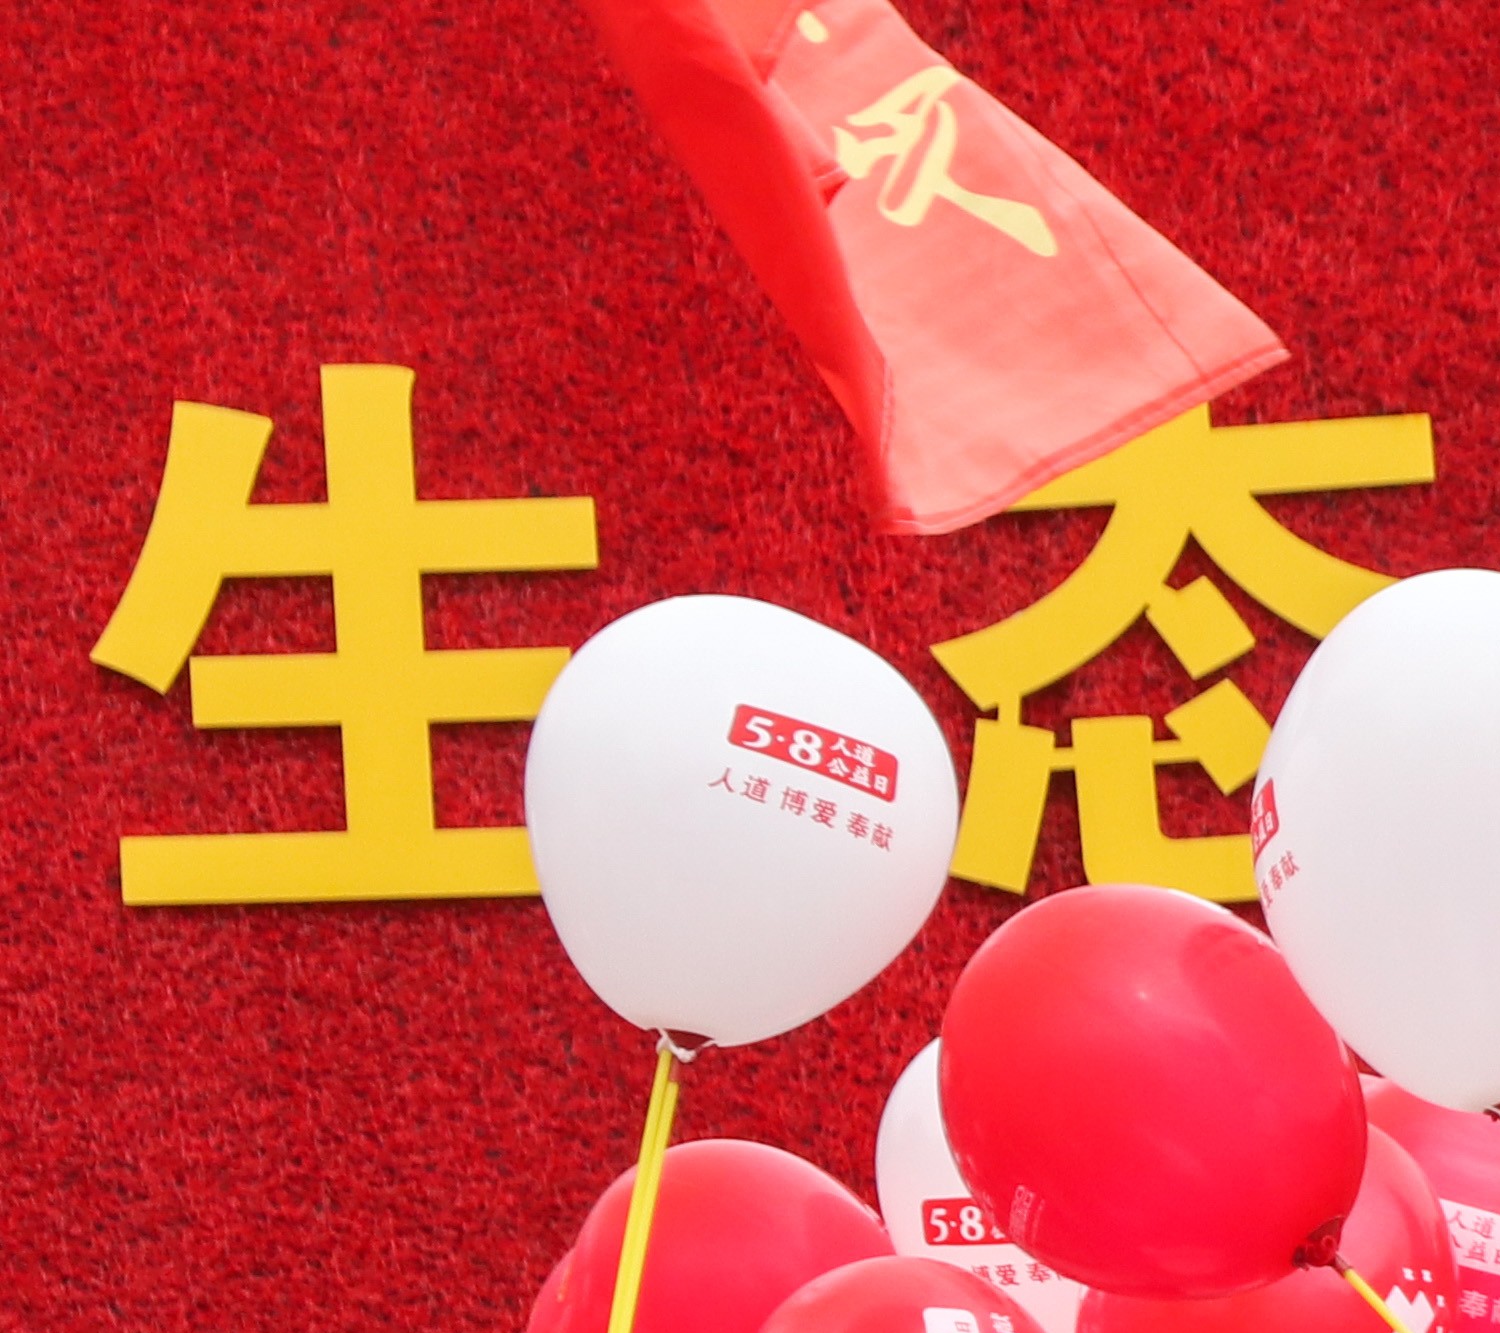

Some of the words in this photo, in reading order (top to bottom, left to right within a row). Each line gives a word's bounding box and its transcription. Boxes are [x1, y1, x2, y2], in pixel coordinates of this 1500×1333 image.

[831, 738, 875, 768] 人道
[828, 758, 890, 795] 公益日
[708, 767, 770, 804] 人道
[780, 786, 837, 828] 博爱
[847, 811, 894, 852] 奉献
[1026, 1263, 1061, 1283] 奉
